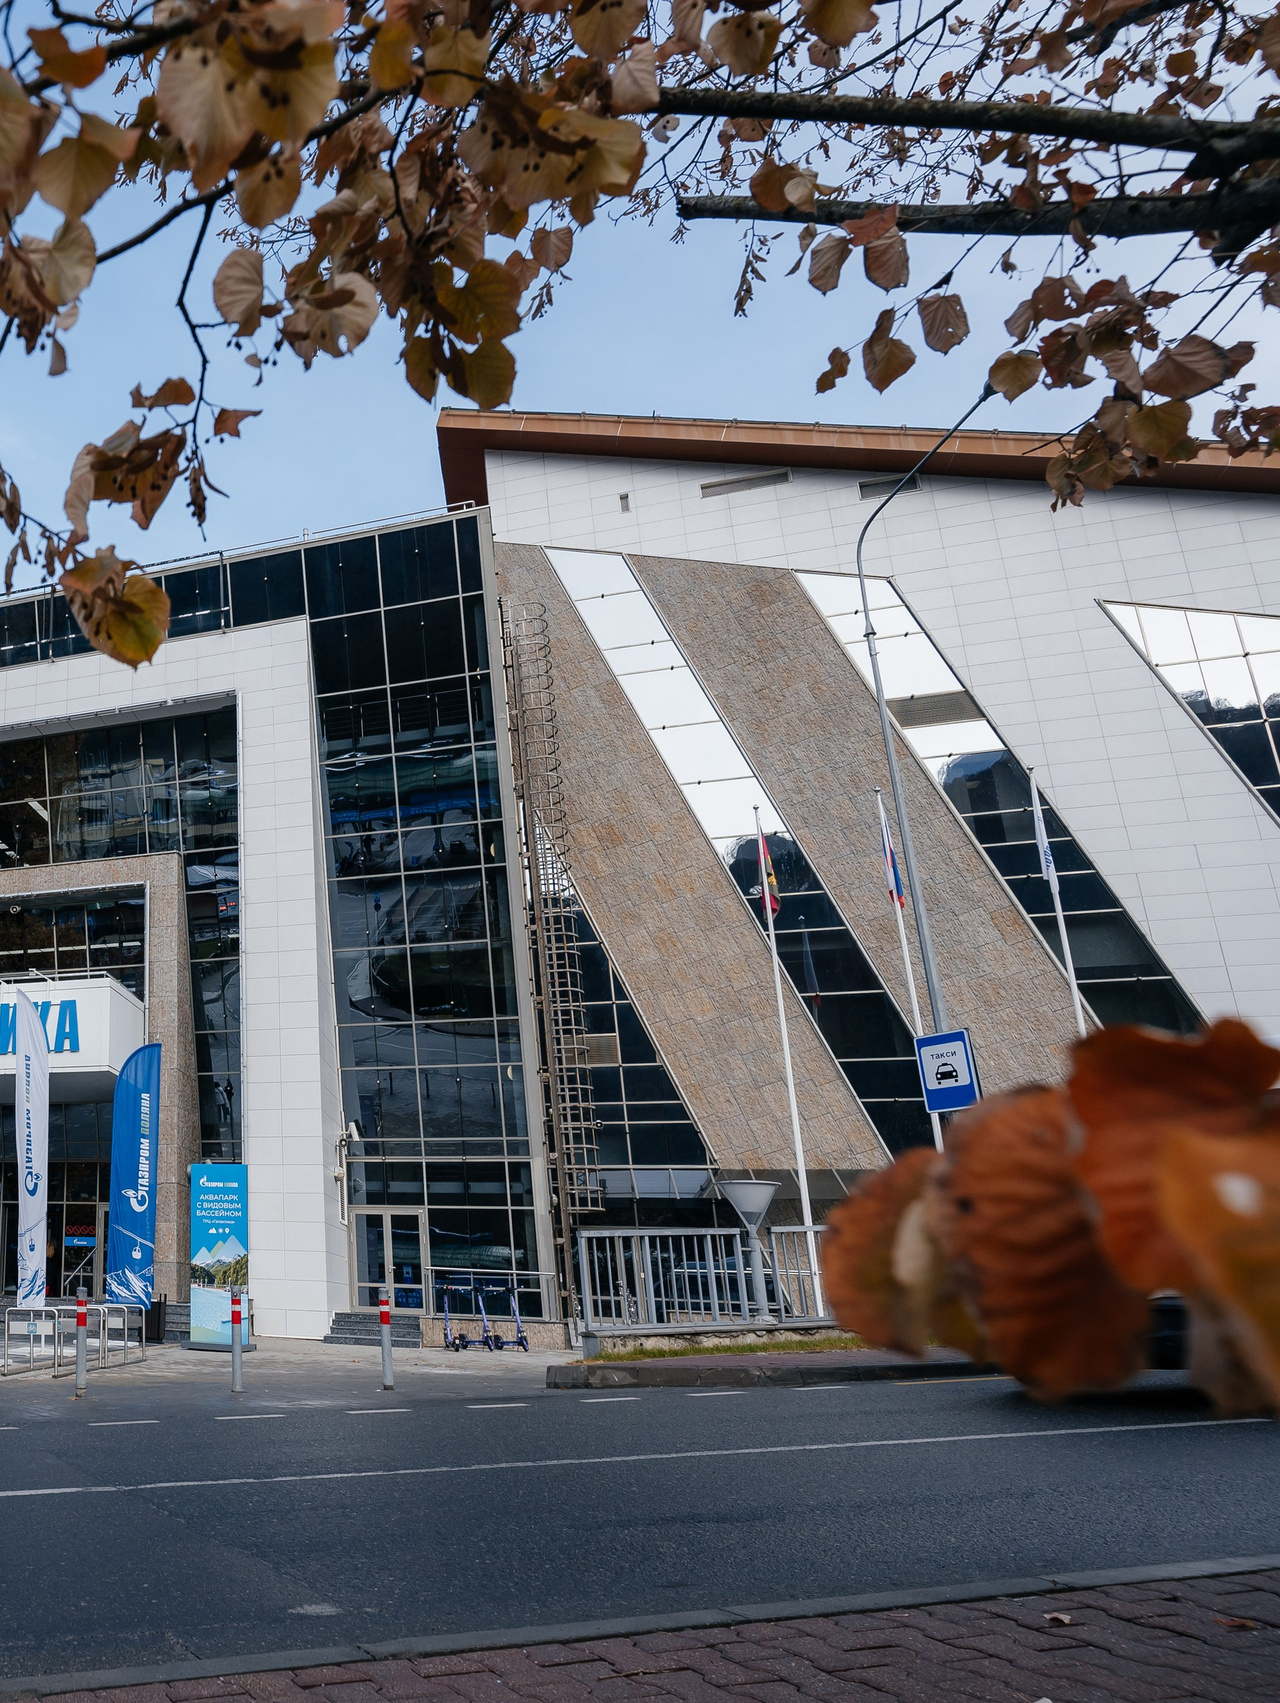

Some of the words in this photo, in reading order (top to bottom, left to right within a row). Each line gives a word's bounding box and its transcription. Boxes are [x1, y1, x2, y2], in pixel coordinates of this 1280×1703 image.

[140, 1093, 150, 1135] ПОЛЯНА
[137, 1138, 150, 1191] ГАЗПРОМ
[196, 1210, 242, 1218] БАССЕЙНОМ
[203, 1202, 242, 1210] ВИДОВЫМ
